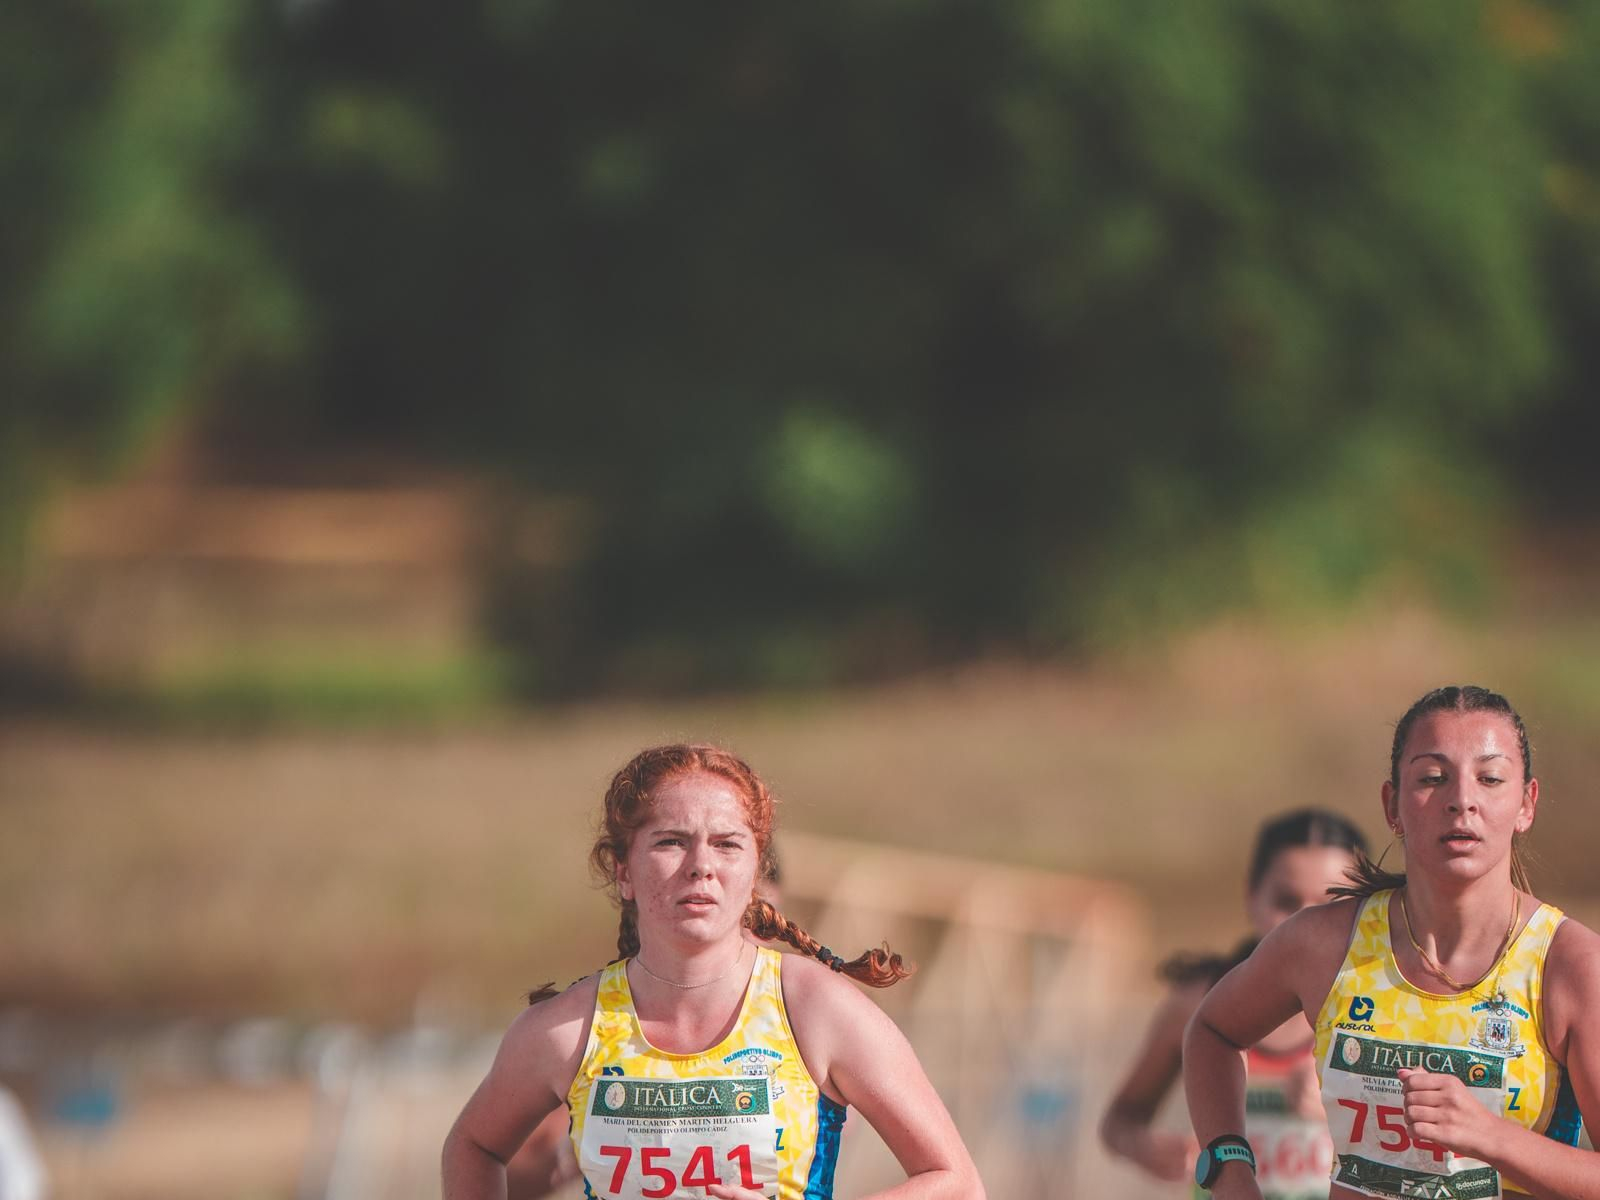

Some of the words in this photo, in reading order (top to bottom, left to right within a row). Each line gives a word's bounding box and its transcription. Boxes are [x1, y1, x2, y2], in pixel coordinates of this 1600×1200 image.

[1371, 1045, 1456, 1073] ITÁLICA
[1362, 1077, 1386, 1087] SILVIA
[633, 1084, 722, 1107] ITÁLICA
[603, 1117, 625, 1126] MARIA
[643, 1119, 677, 1127] CARMEN
[712, 1116, 758, 1125] HELGUERA
[599, 1144, 764, 1199] 7541
